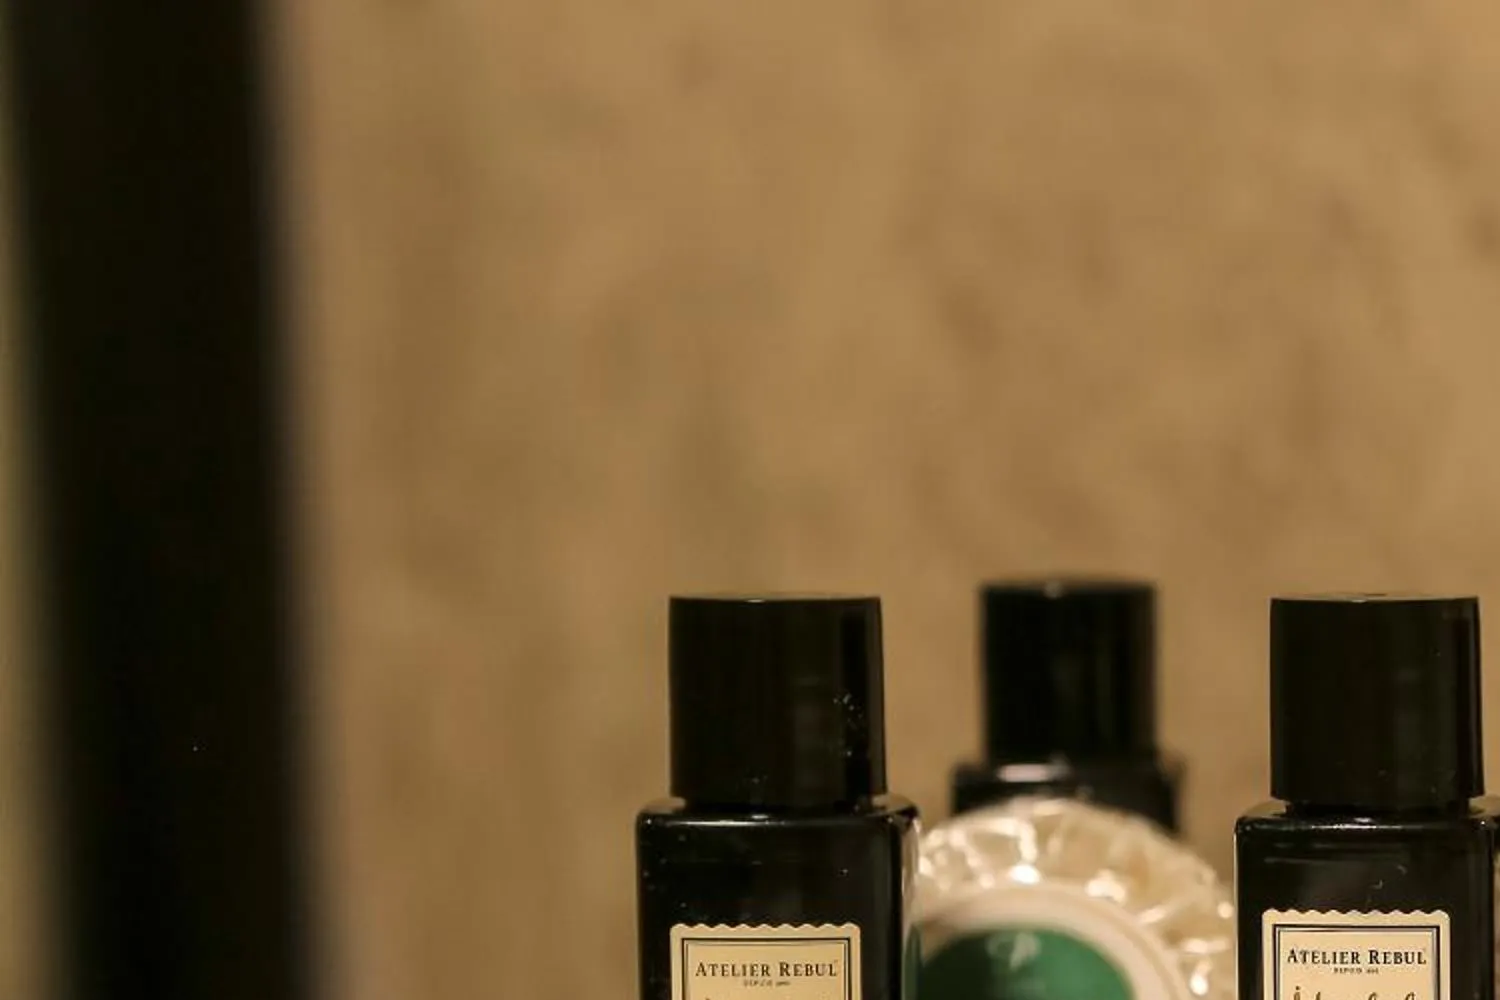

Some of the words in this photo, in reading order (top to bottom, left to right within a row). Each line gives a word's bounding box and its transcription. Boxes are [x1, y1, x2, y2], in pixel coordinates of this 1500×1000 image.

[1287, 949, 1361, 965] ATELIER
[1368, 949, 1427, 965] REBUL
[695, 961, 772, 977] ATELIER
[779, 961, 838, 977] REBUL
